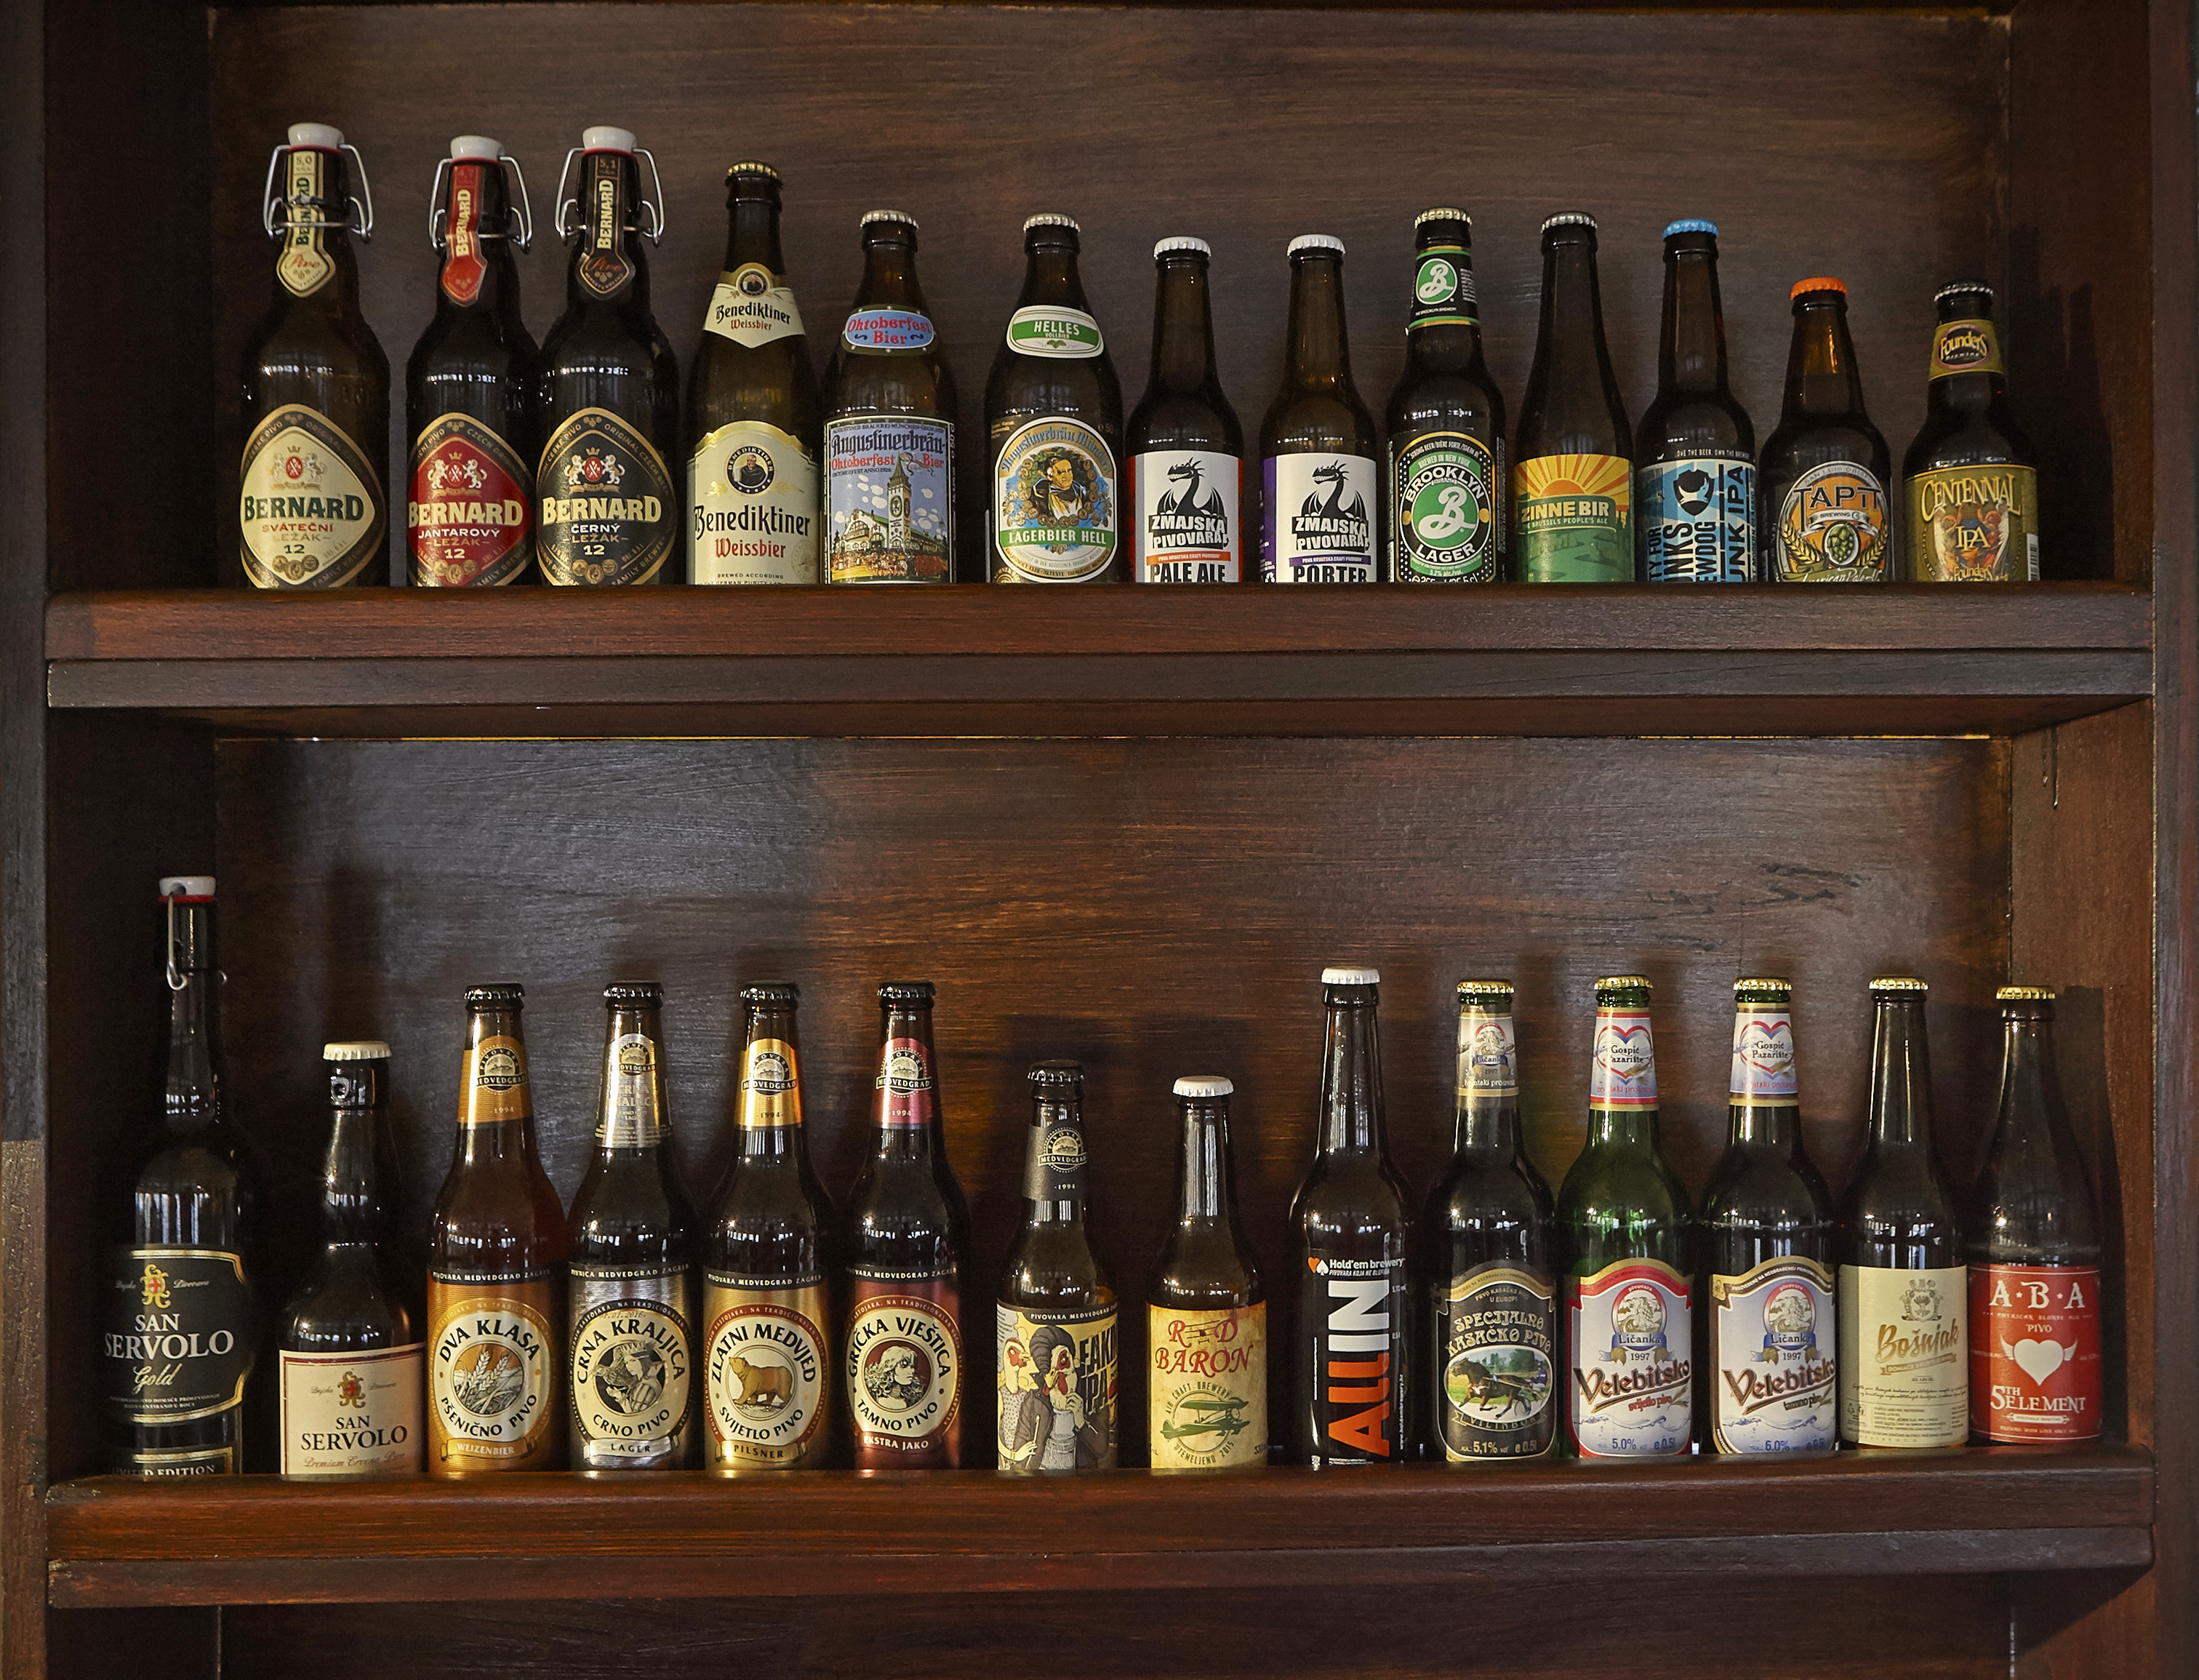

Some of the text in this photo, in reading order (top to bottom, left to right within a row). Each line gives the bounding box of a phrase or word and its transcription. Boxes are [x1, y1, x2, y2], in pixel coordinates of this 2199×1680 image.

[455, 189, 472, 257] BERNARD
[596, 179, 614, 250] BERNARD
[715, 301, 791, 325] Benediktiner
[730, 319, 772, 331] Weissbier
[1034, 320, 1080, 336] HELLES
[873, 330, 908, 345] Bier
[1940, 331, 1988, 361] Founders
[728, 445, 774, 472] BENEDIKTINER
[922, 452, 945, 469] Bier
[1405, 466, 1485, 503] BROOKLYN
[1921, 473, 2022, 522] CENTENNIAL
[244, 495, 364, 523] BERNARD
[409, 499, 524, 528] BERNARD
[542, 495, 662, 526] BERNARD
[1521, 500, 1610, 523] ZINNE BIR
[571, 523, 621, 534] ČERNÝ
[694, 504, 811, 540] Benediktiner
[1151, 515, 1225, 534] ZMAJSKA
[1295, 517, 1367, 537] ZMAJSKA
[1532, 518, 1561, 529] BRUSSELS
[1563, 516, 1595, 525] PEOPLE'S
[1727, 465, 1746, 582] UNK IPA
[418, 528, 500, 540] JANTAROVÝ
[572, 533, 620, 543] LEŽÁK
[1009, 529, 1107, 545] LAGERBIER HELL
[1153, 531, 1228, 549] PIVOVARA
[1297, 534, 1369, 551] PIVOVARA
[1955, 525, 1991, 551] IPA
[284, 544, 305, 554] 12
[444, 548, 466, 559] 12
[583, 545, 605, 555] 12
[715, 537, 786, 559] Weissbier
[1415, 542, 1476, 564] LAGER
[1150, 562, 1226, 583] PALE ALE
[1293, 564, 1368, 583] PORTER
[1610, 1055, 1644, 1064] azarište
[476, 1075, 526, 1086] EDVEDGRAD
[760, 1111, 781, 1119] 1994
[1329, 1257, 1403, 1270] Hold'em brewery
[464, 1273, 521, 1281] MEDVEDGRAD
[598, 1269, 658, 1279] MEDVEDGRAD
[738, 1278, 793, 1287] MEDVEDGRAD
[874, 1270, 929, 1279] MEDVEDGRAD
[1496, 1295, 1518, 1303] EUROPI
[135, 1313, 181, 1332] SAN
[2025, 1323, 2053, 1334] PIVO
[104, 1329, 234, 1360] SERVOLO
[438, 1319, 541, 1364] DVA KLASA
[849, 1318, 889, 1378] GRIČKA
[896, 1316, 951, 1379] VJEŠTICA
[1444, 1325, 1552, 1358] KASAČKO PIVO
[1618, 1333, 1662, 1345] Ličanka
[1770, 1333, 1811, 1345] Ličanka
[1875, 1318, 1960, 1364] Bošnjak
[577, 1329, 609, 1385] CRNA
[611, 1319, 686, 1381] KRALJICA
[711, 1323, 817, 1385] ZLATNI MEDVJED
[1155, 1344, 1254, 1379] BARON
[1630, 1353, 1651, 1361] 1997
[1782, 1352, 1802, 1361] 1997
[132, 1362, 183, 1395] Gold
[1573, 1359, 1691, 1405] Velebitsko
[1721, 1357, 1835, 1407] Velebitsko
[1165, 1381, 1230, 1415] AIR CRAFT BREWERY
[2005, 1395, 2087, 1414] ELEMENT
[335, 1415, 371, 1431] SAN
[441, 1393, 538, 1438] PŠENIČNO PIVO
[593, 1409, 670, 1437] CRNO PIVO
[719, 1406, 804, 1440] SVIJETLO PIVO
[858, 1399, 938, 1431] TAMNO PIVO
[300, 1425, 408, 1452] SERVOLO
[611, 1443, 652, 1453] LAGER
[864, 1436, 929, 1451] EKSTRA JAKO
[456, 1442, 516, 1455] WEIZENBIER
[734, 1444, 784, 1459] PILSNER
[1173, 1443, 1217, 1465] UTEMELJENO
